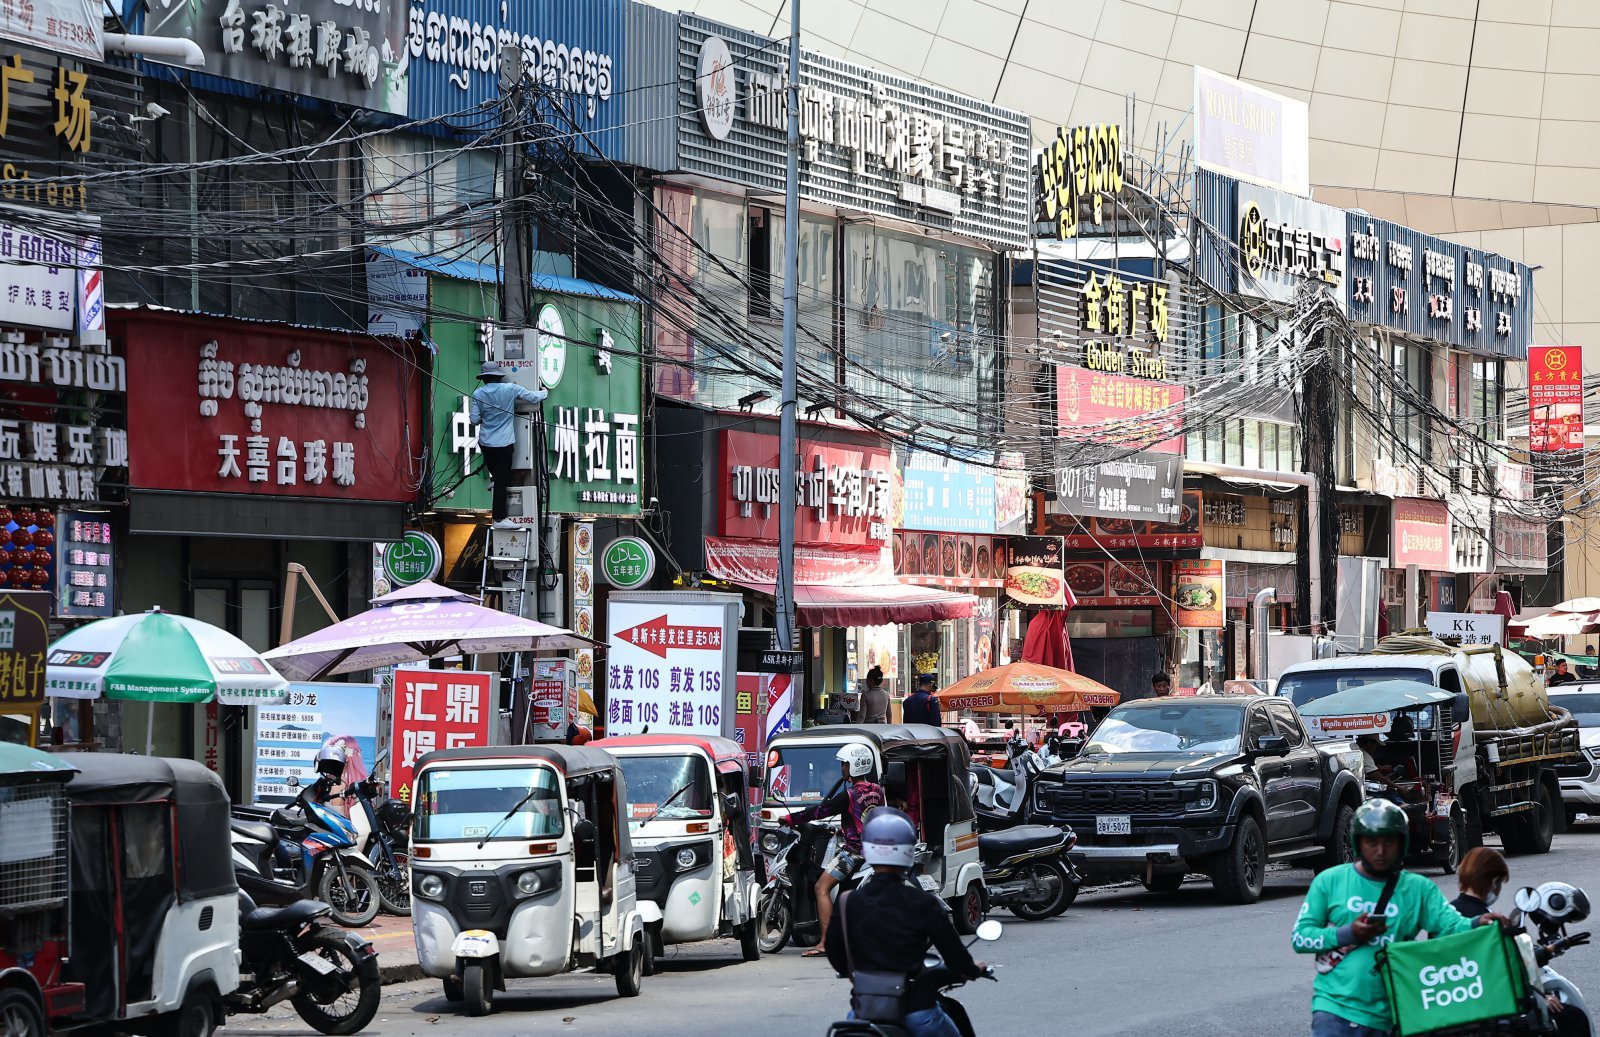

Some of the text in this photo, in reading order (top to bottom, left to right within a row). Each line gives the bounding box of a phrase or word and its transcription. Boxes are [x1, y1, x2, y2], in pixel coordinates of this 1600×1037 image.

[46, 16, 96, 44] 直行30米
[219, 0, 373, 90] 台球棋牌城
[0, 53, 90, 153] 广场
[1206, 87, 1276, 138] ROYAL GROUP
[3, 162, 87, 211] Street
[1083, 269, 1168, 343] 金街广场
[1391, 285, 1408, 316] SPA
[1086, 339, 1167, 380] Golden Street
[1533, 371, 1581, 382] 东方贵足
[218, 434, 356, 486] 天喜台球城
[828, 466, 891, 519] 华润万家
[1060, 468, 1081, 498] 801
[611, 547, 641, 563] حلال
[613, 565, 641, 576] 五年老店
[1440, 584, 1454, 605] ABA
[631, 627, 721, 647] 奥斯卡美发往里走50米
[1453, 620, 1475, 631] KK
[127, 684, 178, 694] Management
[180, 686, 210, 694] System
[609, 664, 634, 691] 洗发
[670, 666, 695, 693] 剪发
[404, 682, 480, 724] 汇鼎
[609, 698, 634, 724] 修面
[669, 701, 694, 727] 洗脸
[950, 695, 994, 708] GANZBERG
[1082, 694, 1115, 704] GANZBERG
[472, 884, 484, 893] RE
[1347, 895, 1399, 918] Grb
[1419, 956, 1479, 987] Grab
[1420, 976, 1484, 1010] Food
